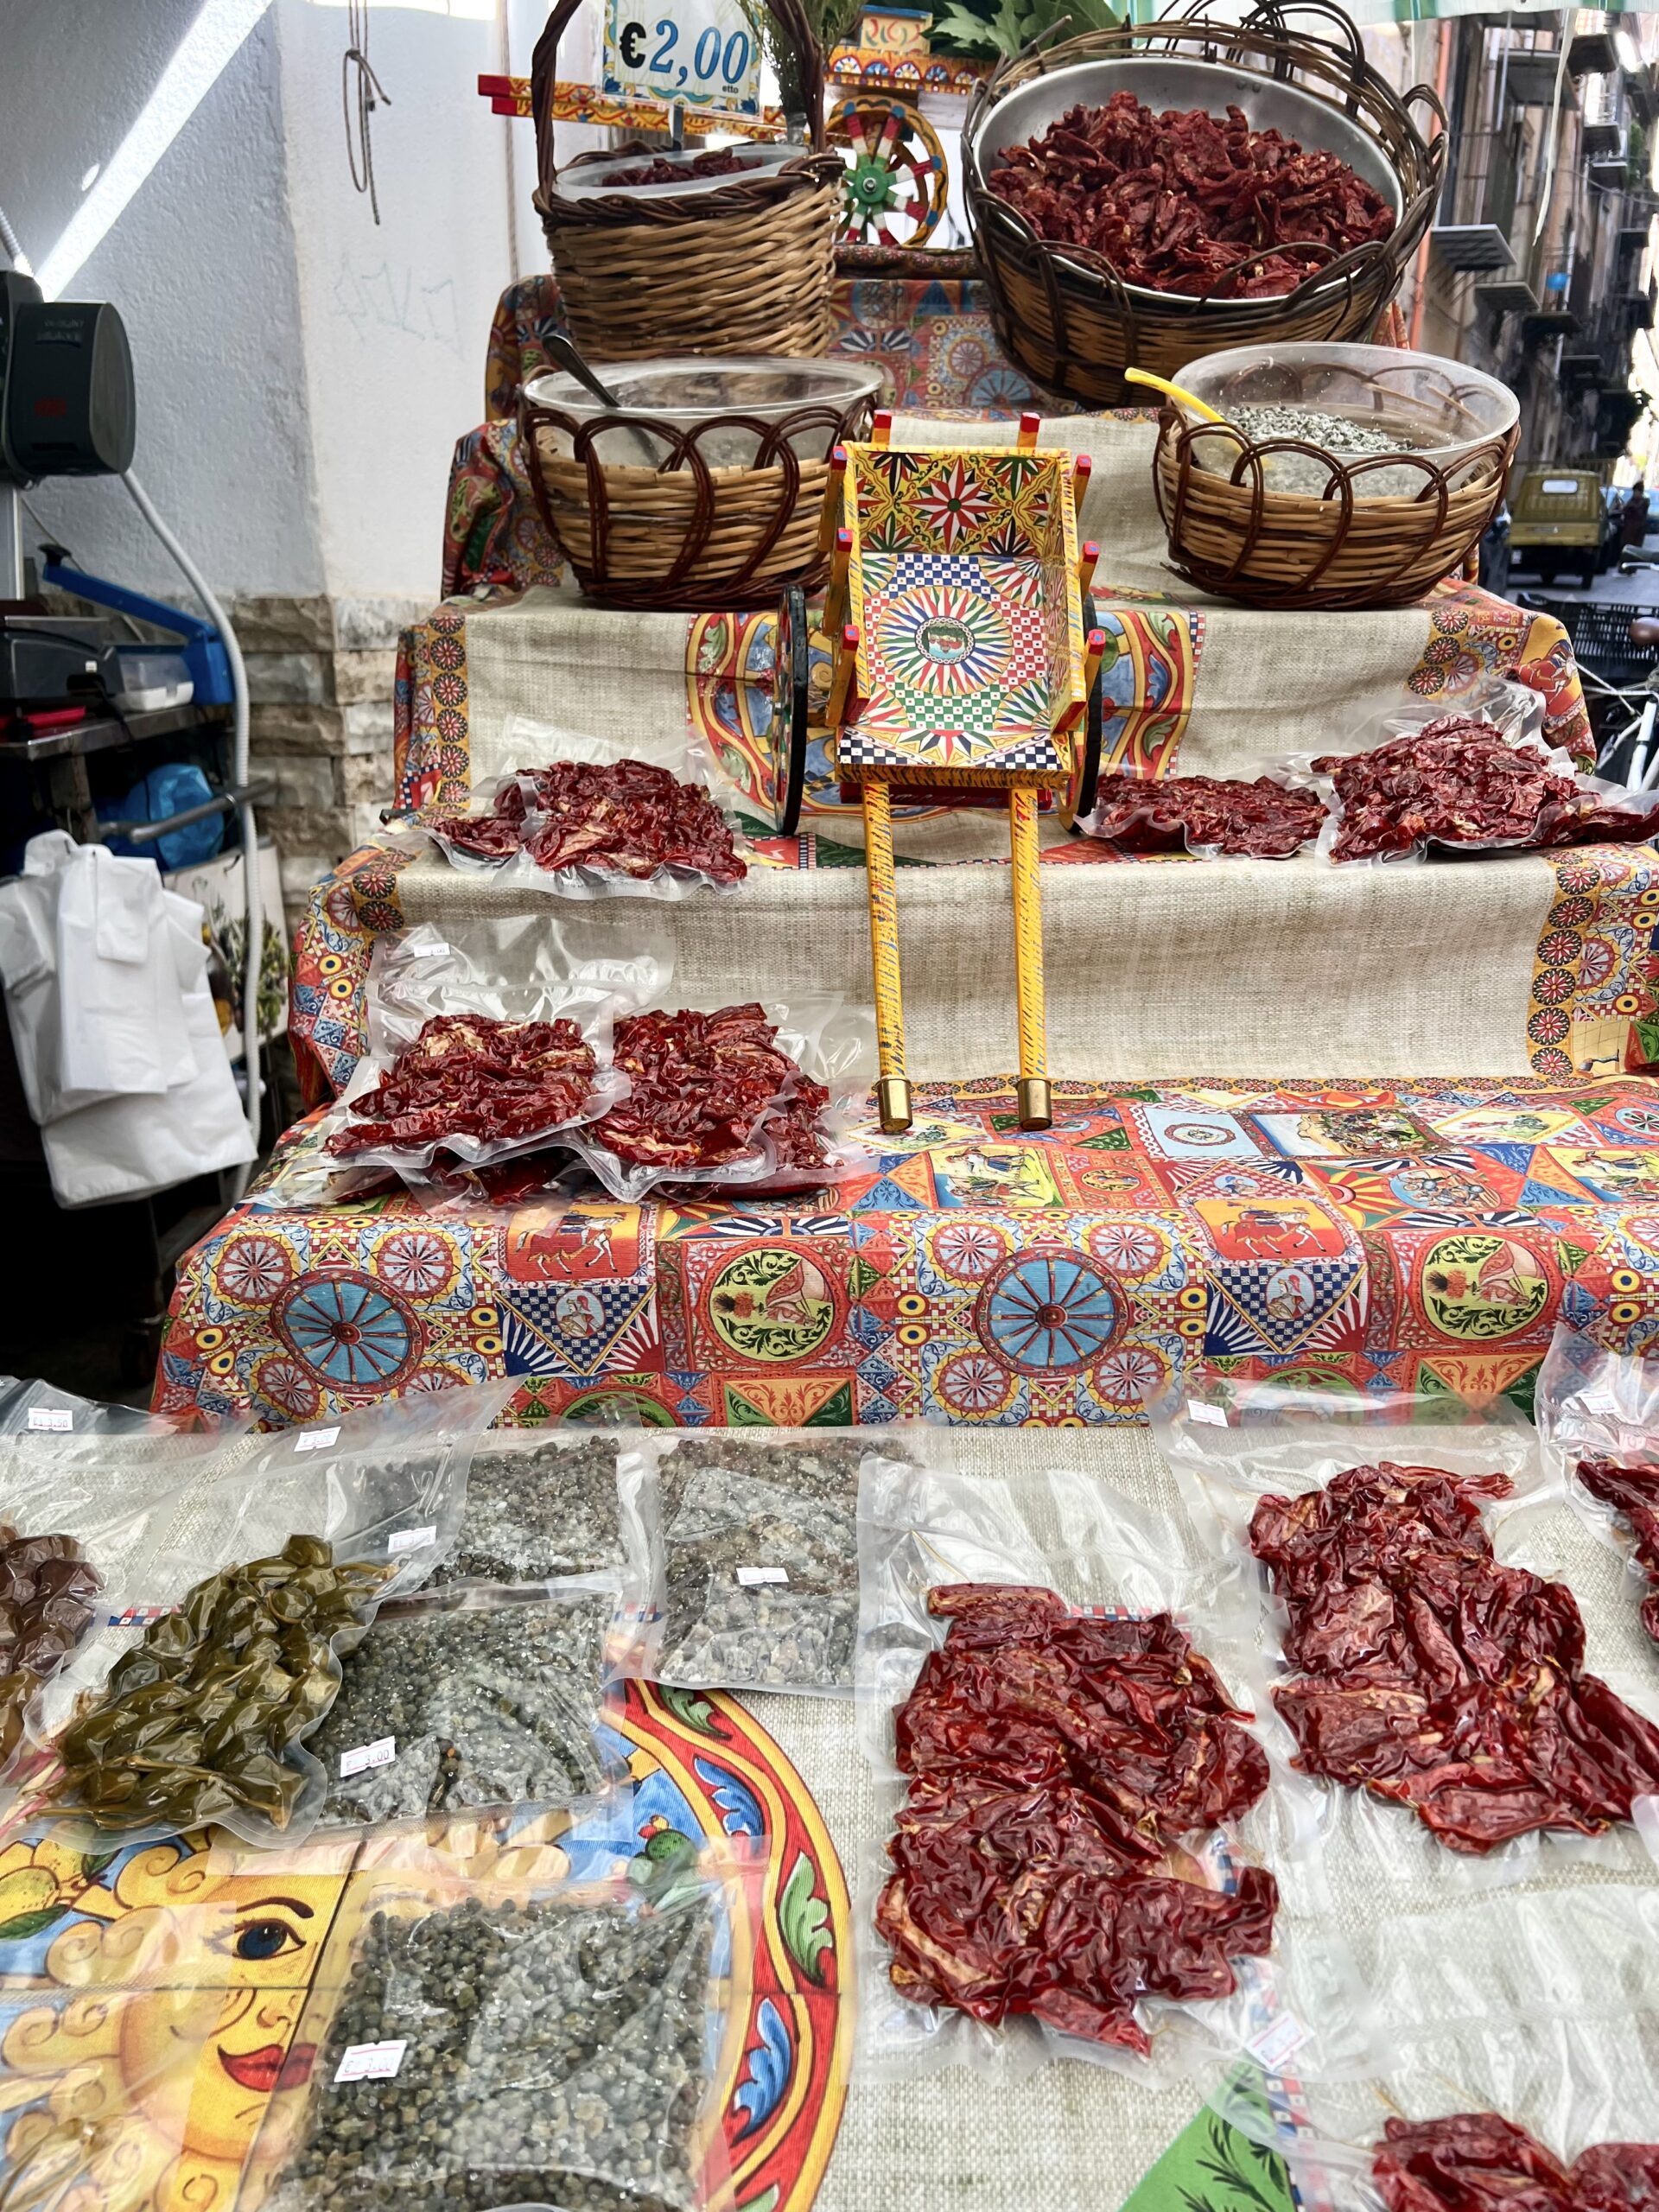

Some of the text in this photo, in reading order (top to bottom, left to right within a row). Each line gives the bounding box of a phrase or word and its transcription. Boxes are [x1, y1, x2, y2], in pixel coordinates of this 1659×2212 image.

[620, 19, 749, 87] €2,00
[722, 86, 739, 94] etto
[365, 1749, 390, 1765] 3.00
